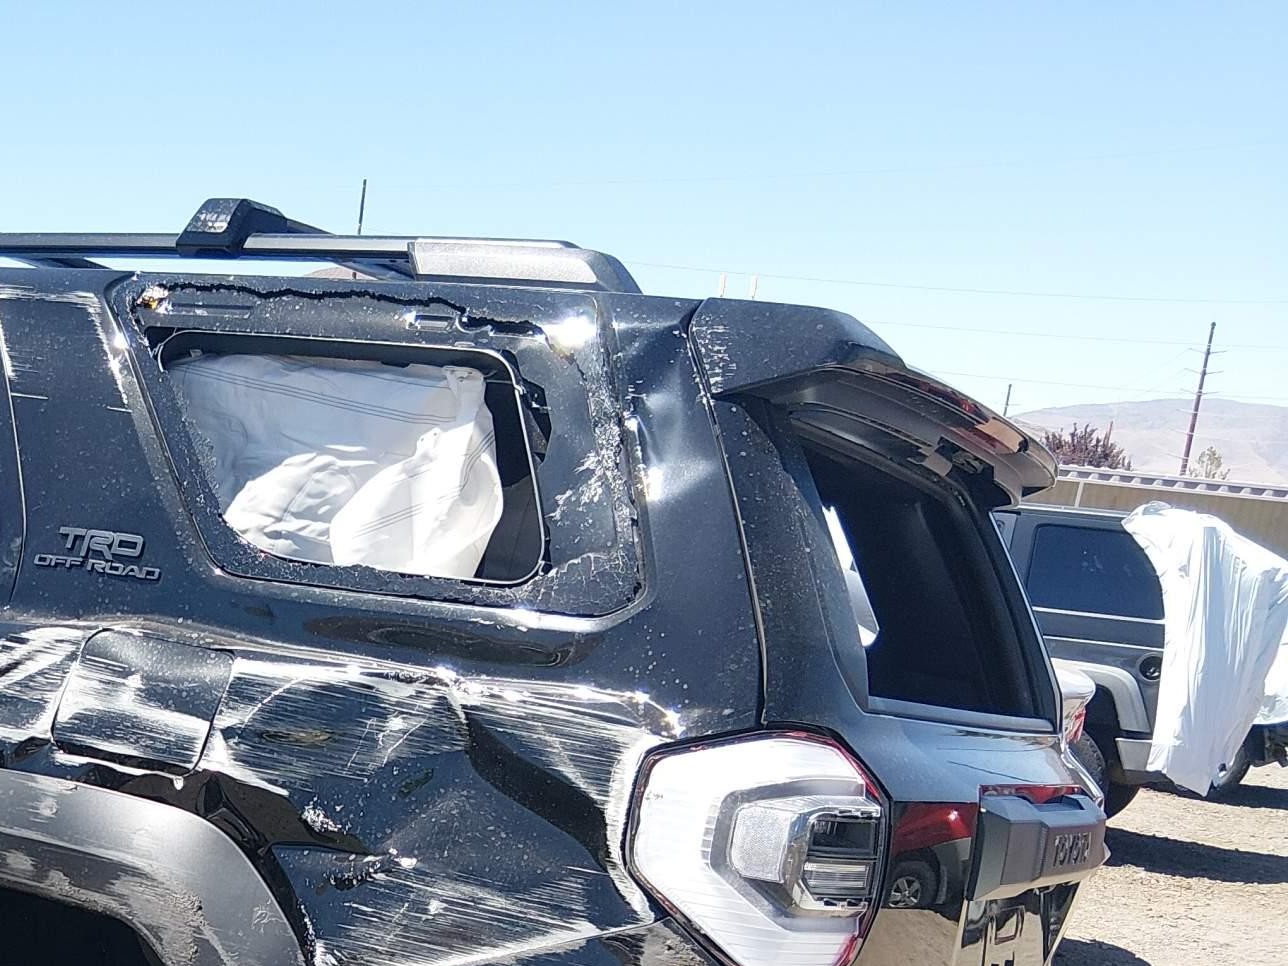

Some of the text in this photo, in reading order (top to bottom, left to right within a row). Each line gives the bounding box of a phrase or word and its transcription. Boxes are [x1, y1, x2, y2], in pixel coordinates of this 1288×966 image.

[59, 526, 144, 560] TRD
[33, 554, 161, 580] OFF ROAD
